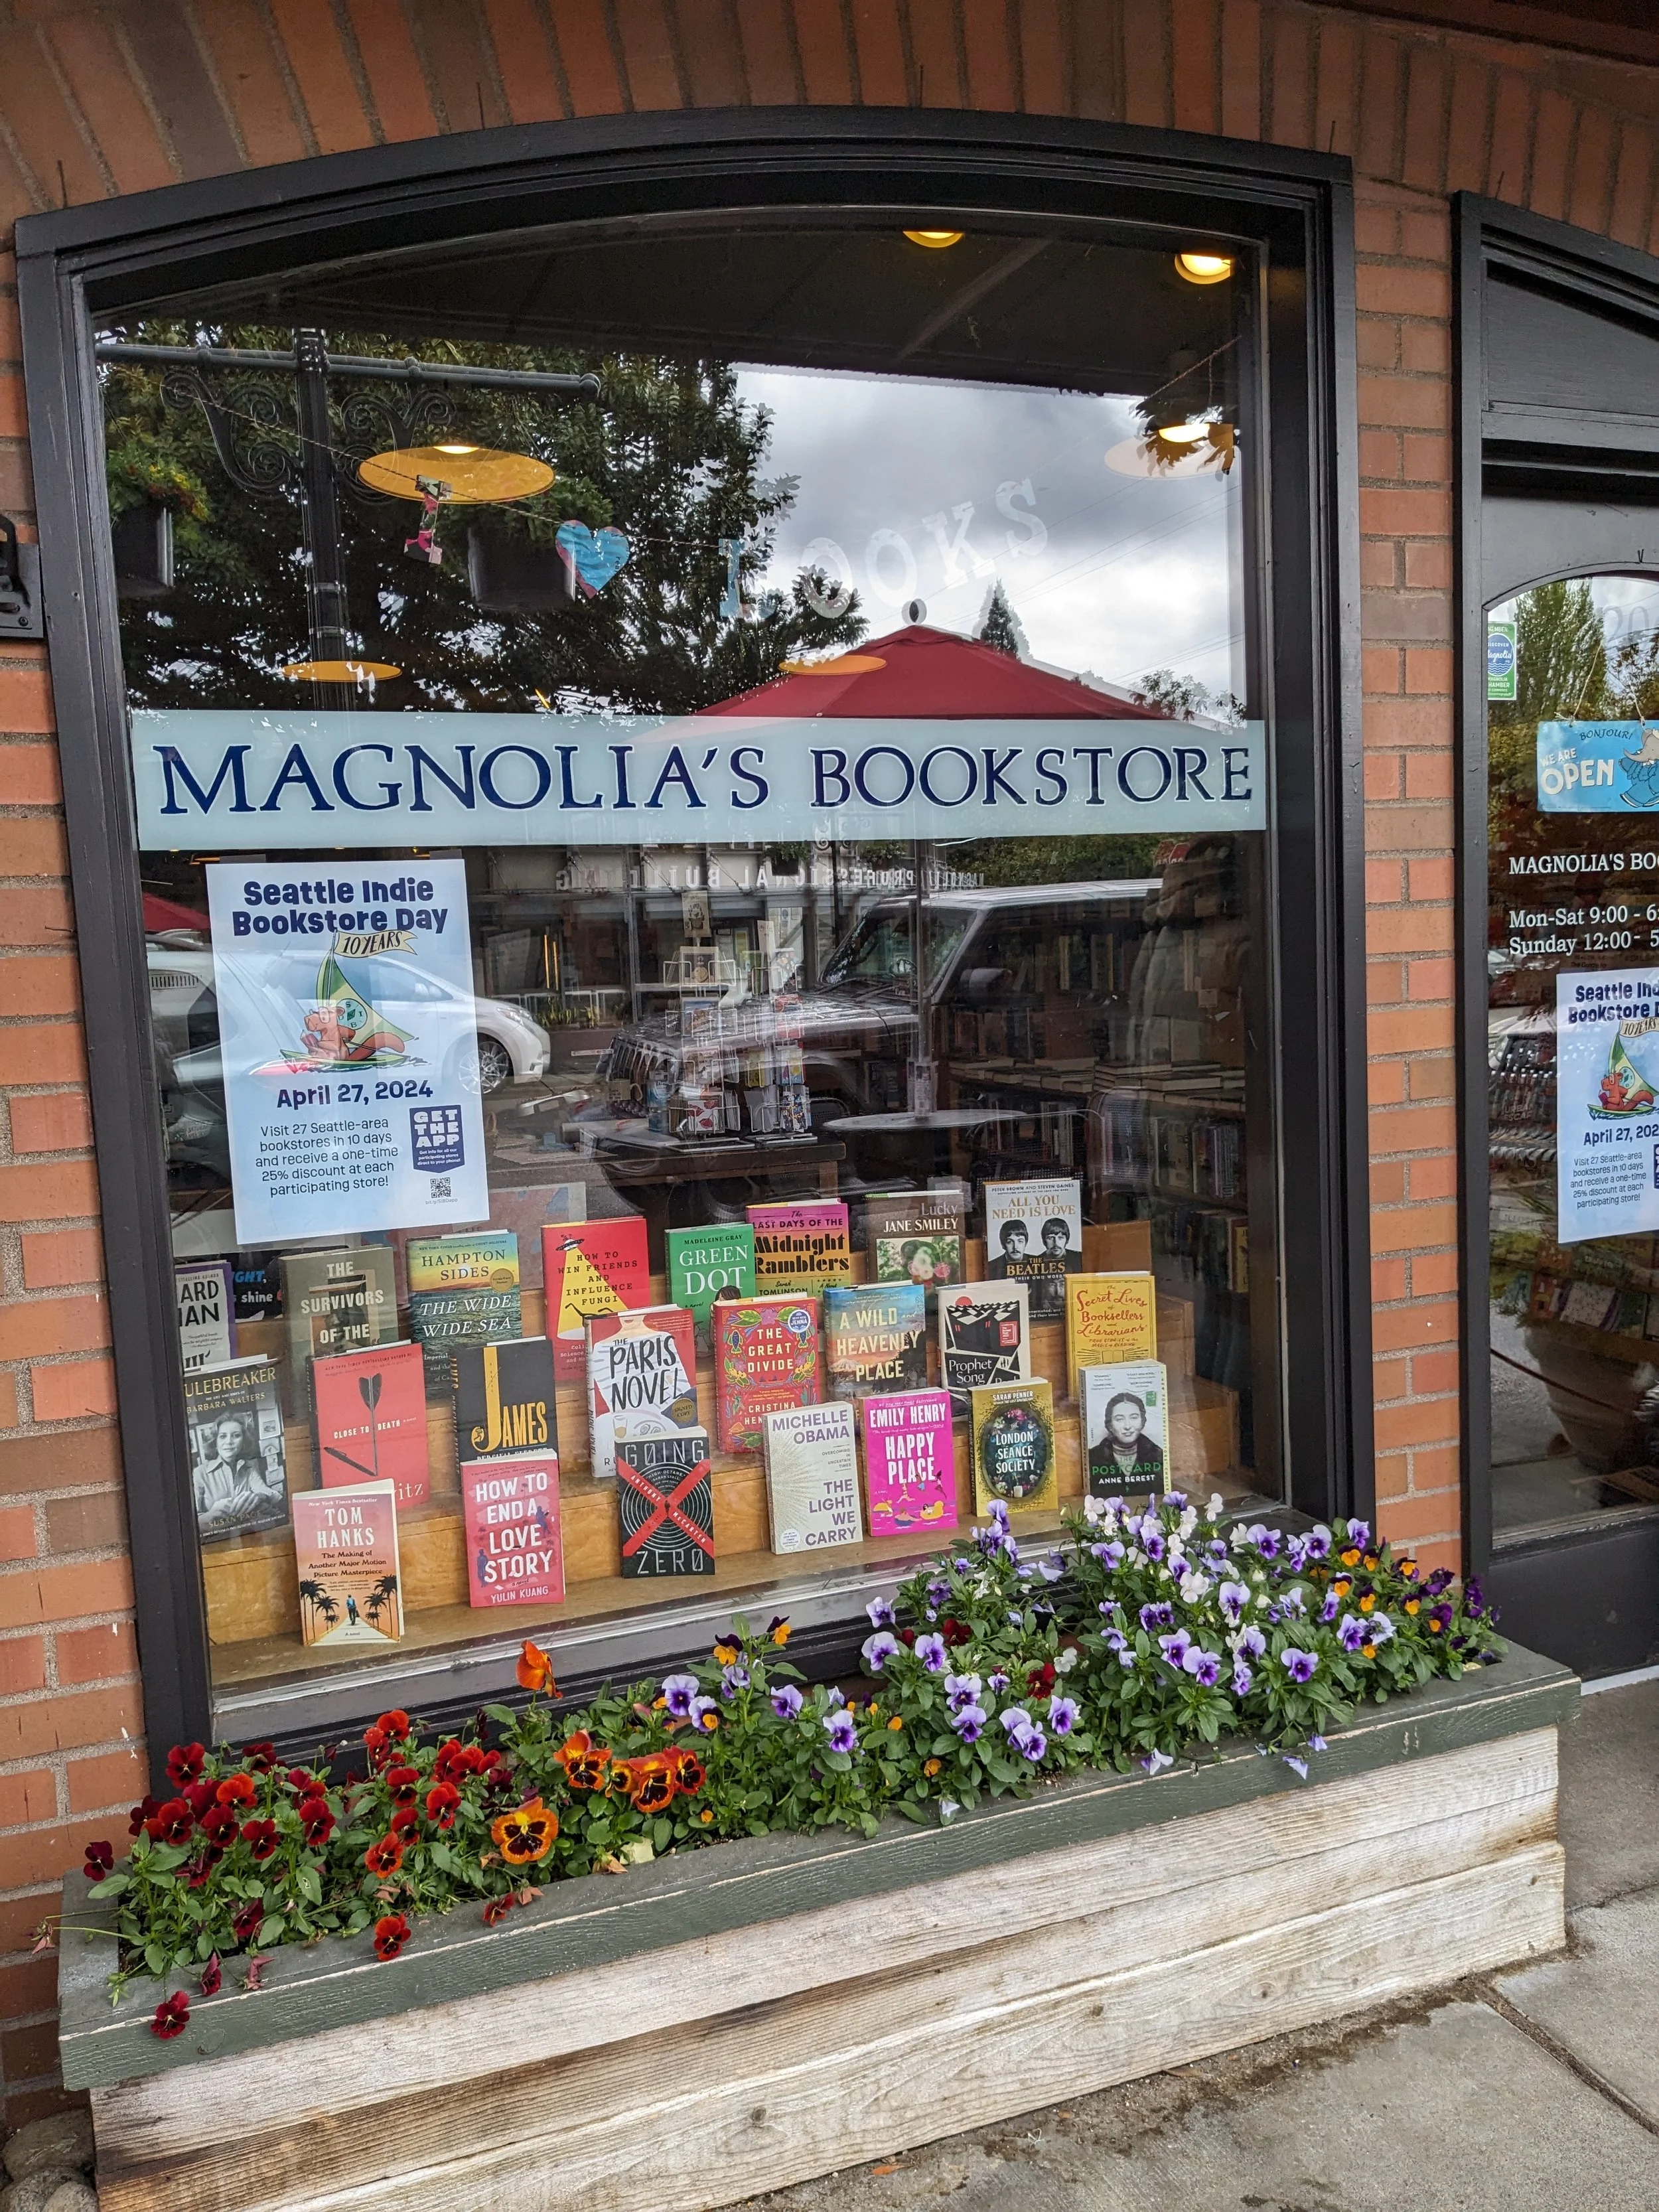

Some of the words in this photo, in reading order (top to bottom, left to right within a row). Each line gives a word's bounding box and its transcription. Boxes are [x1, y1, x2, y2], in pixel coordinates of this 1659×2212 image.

[1580, 729, 1632, 741] BONJOUR!
[1540, 752, 1555, 767] WE
[1557, 747, 1577, 761] ARE
[153, 743, 769, 815] MAGNOLIA'S
[809, 745, 1252, 808] BOOKSTORE
[1540, 759, 1614, 795] OPEN
[1509, 853, 1624, 874] MAGNOLIA'S
[244, 879, 354, 906] Seattle
[362, 877, 434, 903] Indie
[232, 908, 388, 936] Bookstore
[397, 909, 448, 934] Day
[1509, 908, 1584, 928] Mon-Sat
[1590, 906, 1627, 924] 9:00
[1510, 934, 1577, 956] Sunday
[1584, 931, 1631, 950] 12:00
[1575, 982, 1632, 1003] Seattle
[1568, 1003, 1650, 1024] Bookstore
[277, 1084, 330, 1110] April
[338, 1084, 369, 1105] 27,
[376, 1080, 433, 1100] 2024
[414, 1110, 457, 1123] GET
[261, 1126, 289, 1137] Visit
[293, 1124, 307, 1134] 27
[311, 1118, 388, 1134] Seattle-area
[415, 1122, 459, 1135] THE
[1583, 1129, 1612, 1147] April
[1616, 1128, 1632, 1142] 27,
[260, 1136, 330, 1152] bookstores
[334, 1135, 344, 1147] in
[347, 1134, 360, 1145] 10
[364, 1131, 392, 1144] days
[416, 1134, 459, 1147] APP
[256, 1154, 278, 1168] and
[283, 1150, 328, 1165] receive
[332, 1152, 338, 1161] a
[342, 1147, 397, 1159] one-time
[262, 1169, 289, 1181] 25%
[292, 1164, 346, 1179] discount
[349, 1163, 361, 1174] at
[364, 1161, 394, 1173] each
[271, 1179, 349, 1198] participating
[353, 1175, 389, 1189] store!
[922, 1202, 958, 1218] Lucky
[1009, 1197, 1031, 1207] ALL
[1035, 1195, 1059, 1206] YOU
[992, 1208, 1025, 1219] NEED
[1029, 1207, 1041, 1217] IS
[1045, 1205, 1075, 1216] LOVE
[779, 1219, 804, 1228] DAYS
[826, 1218, 843, 1226] THE
[884, 1220, 912, 1233] JANE
[914, 1218, 958, 1232] SMILEY
[684, 1236, 723, 1244] MADELEINE
[754, 1233, 845, 1256] Midnight
[421, 1250, 506, 1267] HAMPTON
[680, 1245, 749, 1266] GREEN
[755, 1255, 849, 1274] Ramblers
[326, 1262, 353, 1277] THE
[441, 1266, 489, 1281] SIDES
[558, 1266, 580, 1274] WIN
[587, 1260, 638, 1272] FRIENDS
[1007, 1262, 1065, 1276] BEATLES
[566, 1283, 632, 1296] INFLUENCE
[684, 1266, 746, 1295] DOT
[301, 1290, 384, 1313] SURVIVORS
[421, 1300, 457, 1316] THE
[464, 1295, 512, 1312] WIDE
[582, 1295, 618, 1305] FUNGI
[1076, 1290, 1113, 1311] Secret
[1114, 1289, 1147, 1307] Lives
[839, 1312, 850, 1329] A
[856, 1307, 897, 1327] WILD
[1082, 1310, 1144, 1323] Booksellers
[320, 1328, 340, 1344] OF
[342, 1324, 370, 1341] THE
[423, 1321, 472, 1338] WIDE
[478, 1317, 512, 1332] SEA
[757, 1327, 782, 1340] THE
[613, 1337, 628, 1347] THE
[749, 1343, 792, 1357] GREAT
[837, 1331, 919, 1356] HEAVENLY
[610, 1335, 677, 1379] PARIS
[747, 1359, 794, 1373] DIVIDE
[949, 1359, 992, 1374] Prophet
[856, 1361, 904, 1382] PLACE
[957, 1372, 985, 1385] Song
[184, 1367, 276, 1397] ULEBREAKER
[611, 1368, 683, 1413] NOVEL
[186, 1400, 226, 1414] BARBARA
[230, 1392, 265, 1404] WALTERS
[471, 1346, 547, 1452] JAMES
[749, 1402, 796, 1413] CRISTINA
[772, 1409, 848, 1432] MICHELLE
[869, 1408, 904, 1428] EMILY
[910, 1402, 946, 1424] HENRY
[334, 1429, 357, 1439] CLOSE
[378, 1420, 400, 1431] DEATH
[793, 1426, 850, 1444] OBAMA
[996, 1431, 1033, 1445] LONDON
[885, 1432, 935, 1460] HAPPY
[998, 1443, 1033, 1459] SÉANCE
[887, 1457, 936, 1485] PLACE
[996, 1459, 1036, 1474] SOCIETY
[1092, 1462, 1161, 1475] POSTCARD
[476, 1477, 518, 1503] HOW
[525, 1473, 547, 1492] TO
[630, 1475, 662, 1502] ANTHONY
[824, 1479, 853, 1494] THE
[1098, 1476, 1122, 1485] ANNE
[1125, 1474, 1155, 1483] BEREST
[487, 1501, 523, 1524] END
[528, 1498, 538, 1516] A
[808, 1495, 854, 1513] LIGHT
[325, 1507, 363, 1526] TOM
[831, 1511, 855, 1526] WE
[673, 1511, 707, 1544] McCARTEN
[805, 1526, 857, 1546] CARRY
[317, 1527, 374, 1549] HANKS
[489, 1524, 541, 1554] LOVE
[484, 1550, 553, 1583] STORY
[490, 1590, 516, 1603] YULIN
[520, 1585, 549, 1599] KUANG
